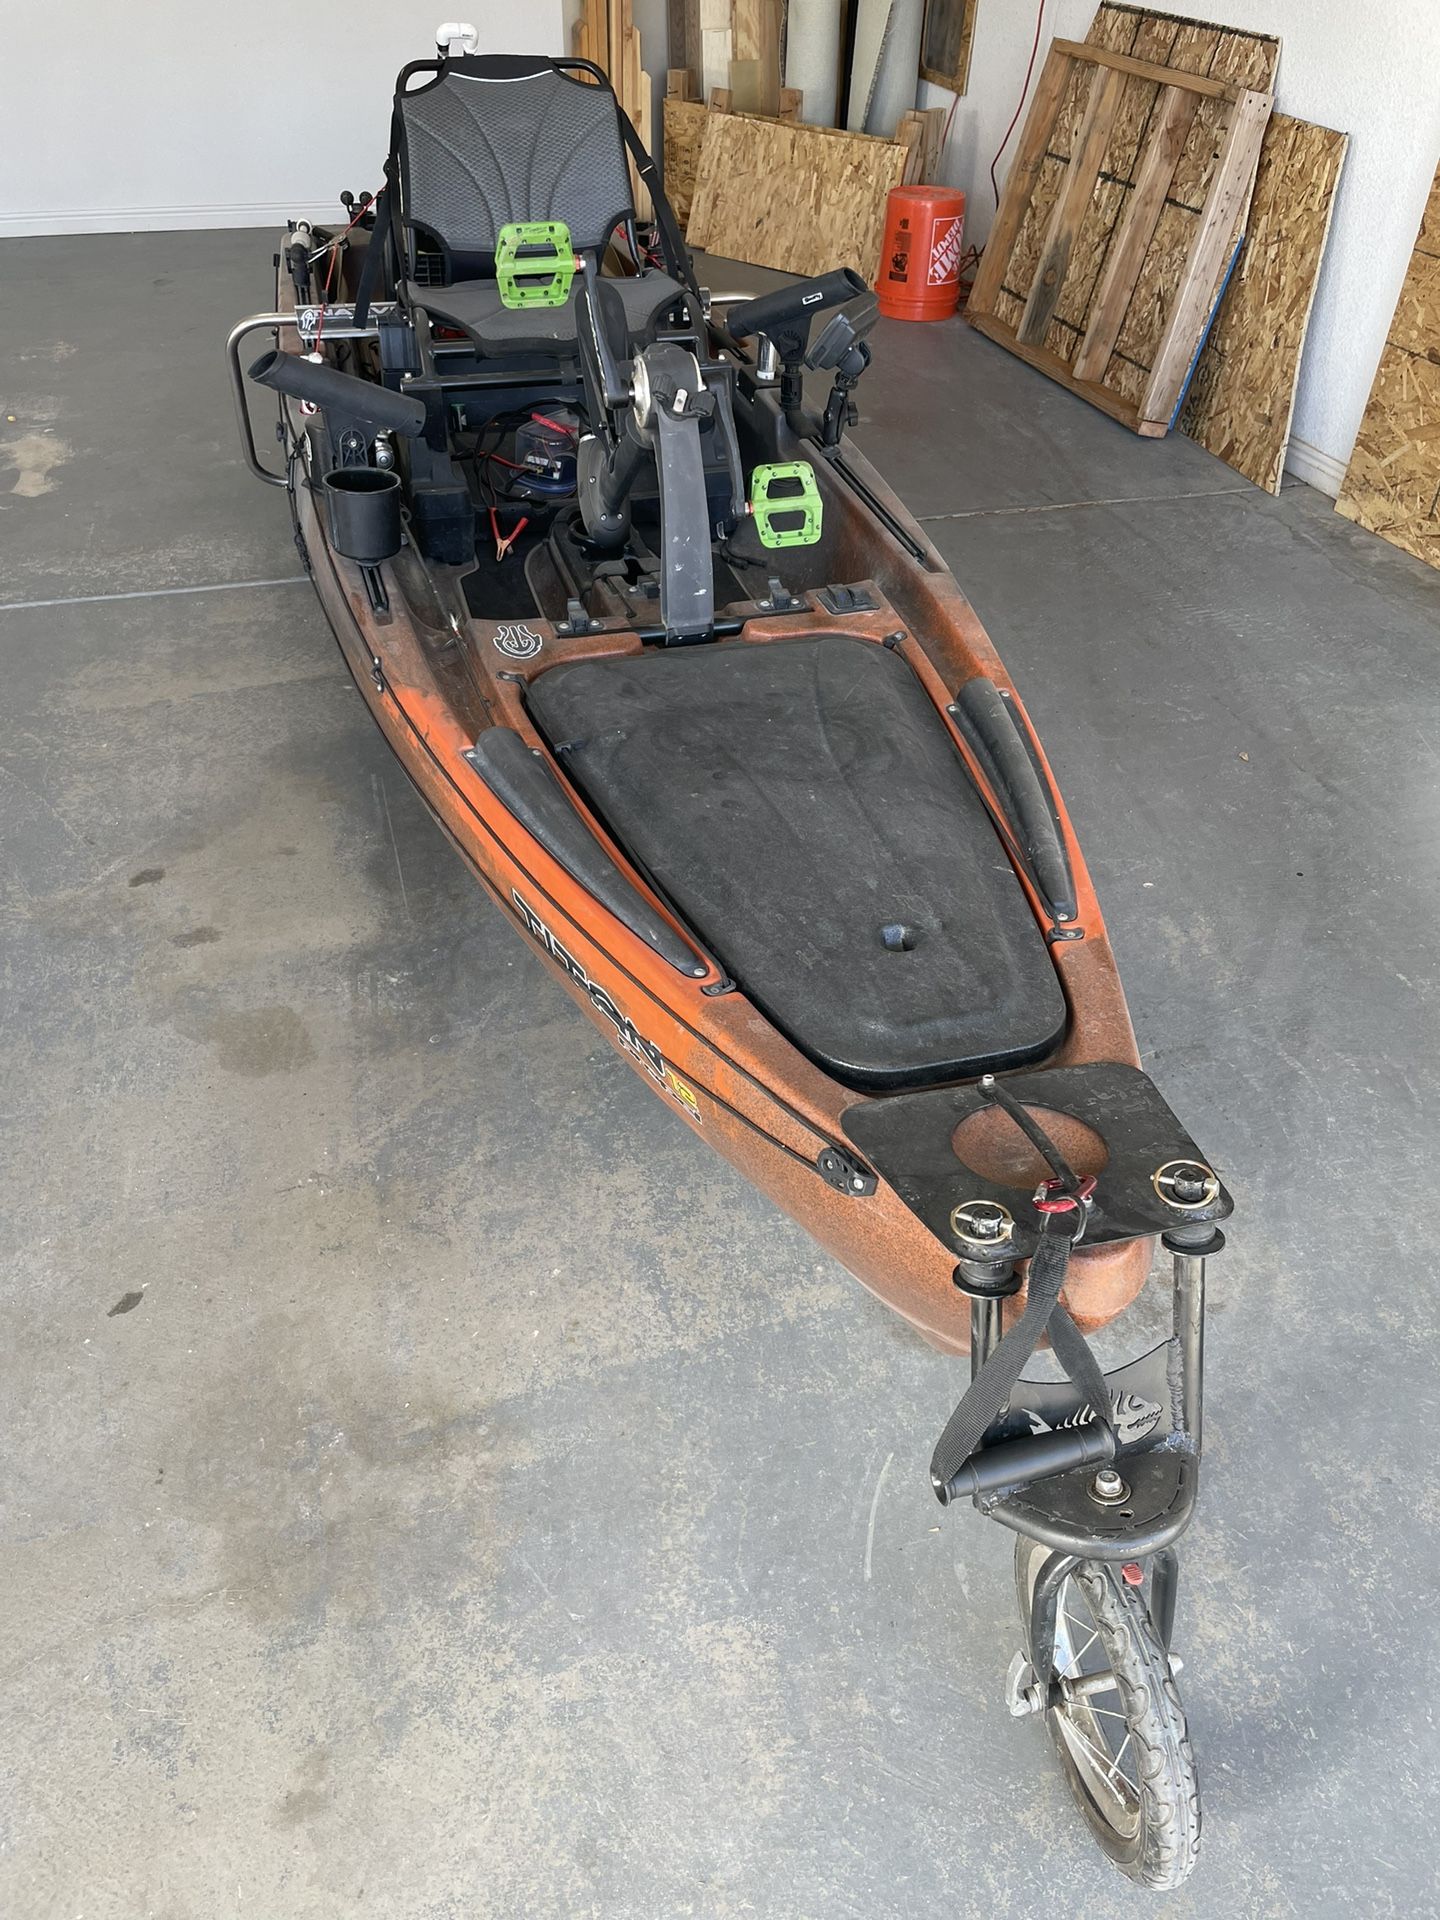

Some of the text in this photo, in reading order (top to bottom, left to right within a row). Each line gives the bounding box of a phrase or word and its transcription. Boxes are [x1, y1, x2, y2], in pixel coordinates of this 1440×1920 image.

[930, 226, 964, 283] OME
[313, 306, 396, 317] NAV
[512, 888, 666, 1077] TITAN
[665, 1067, 699, 1110] 12
